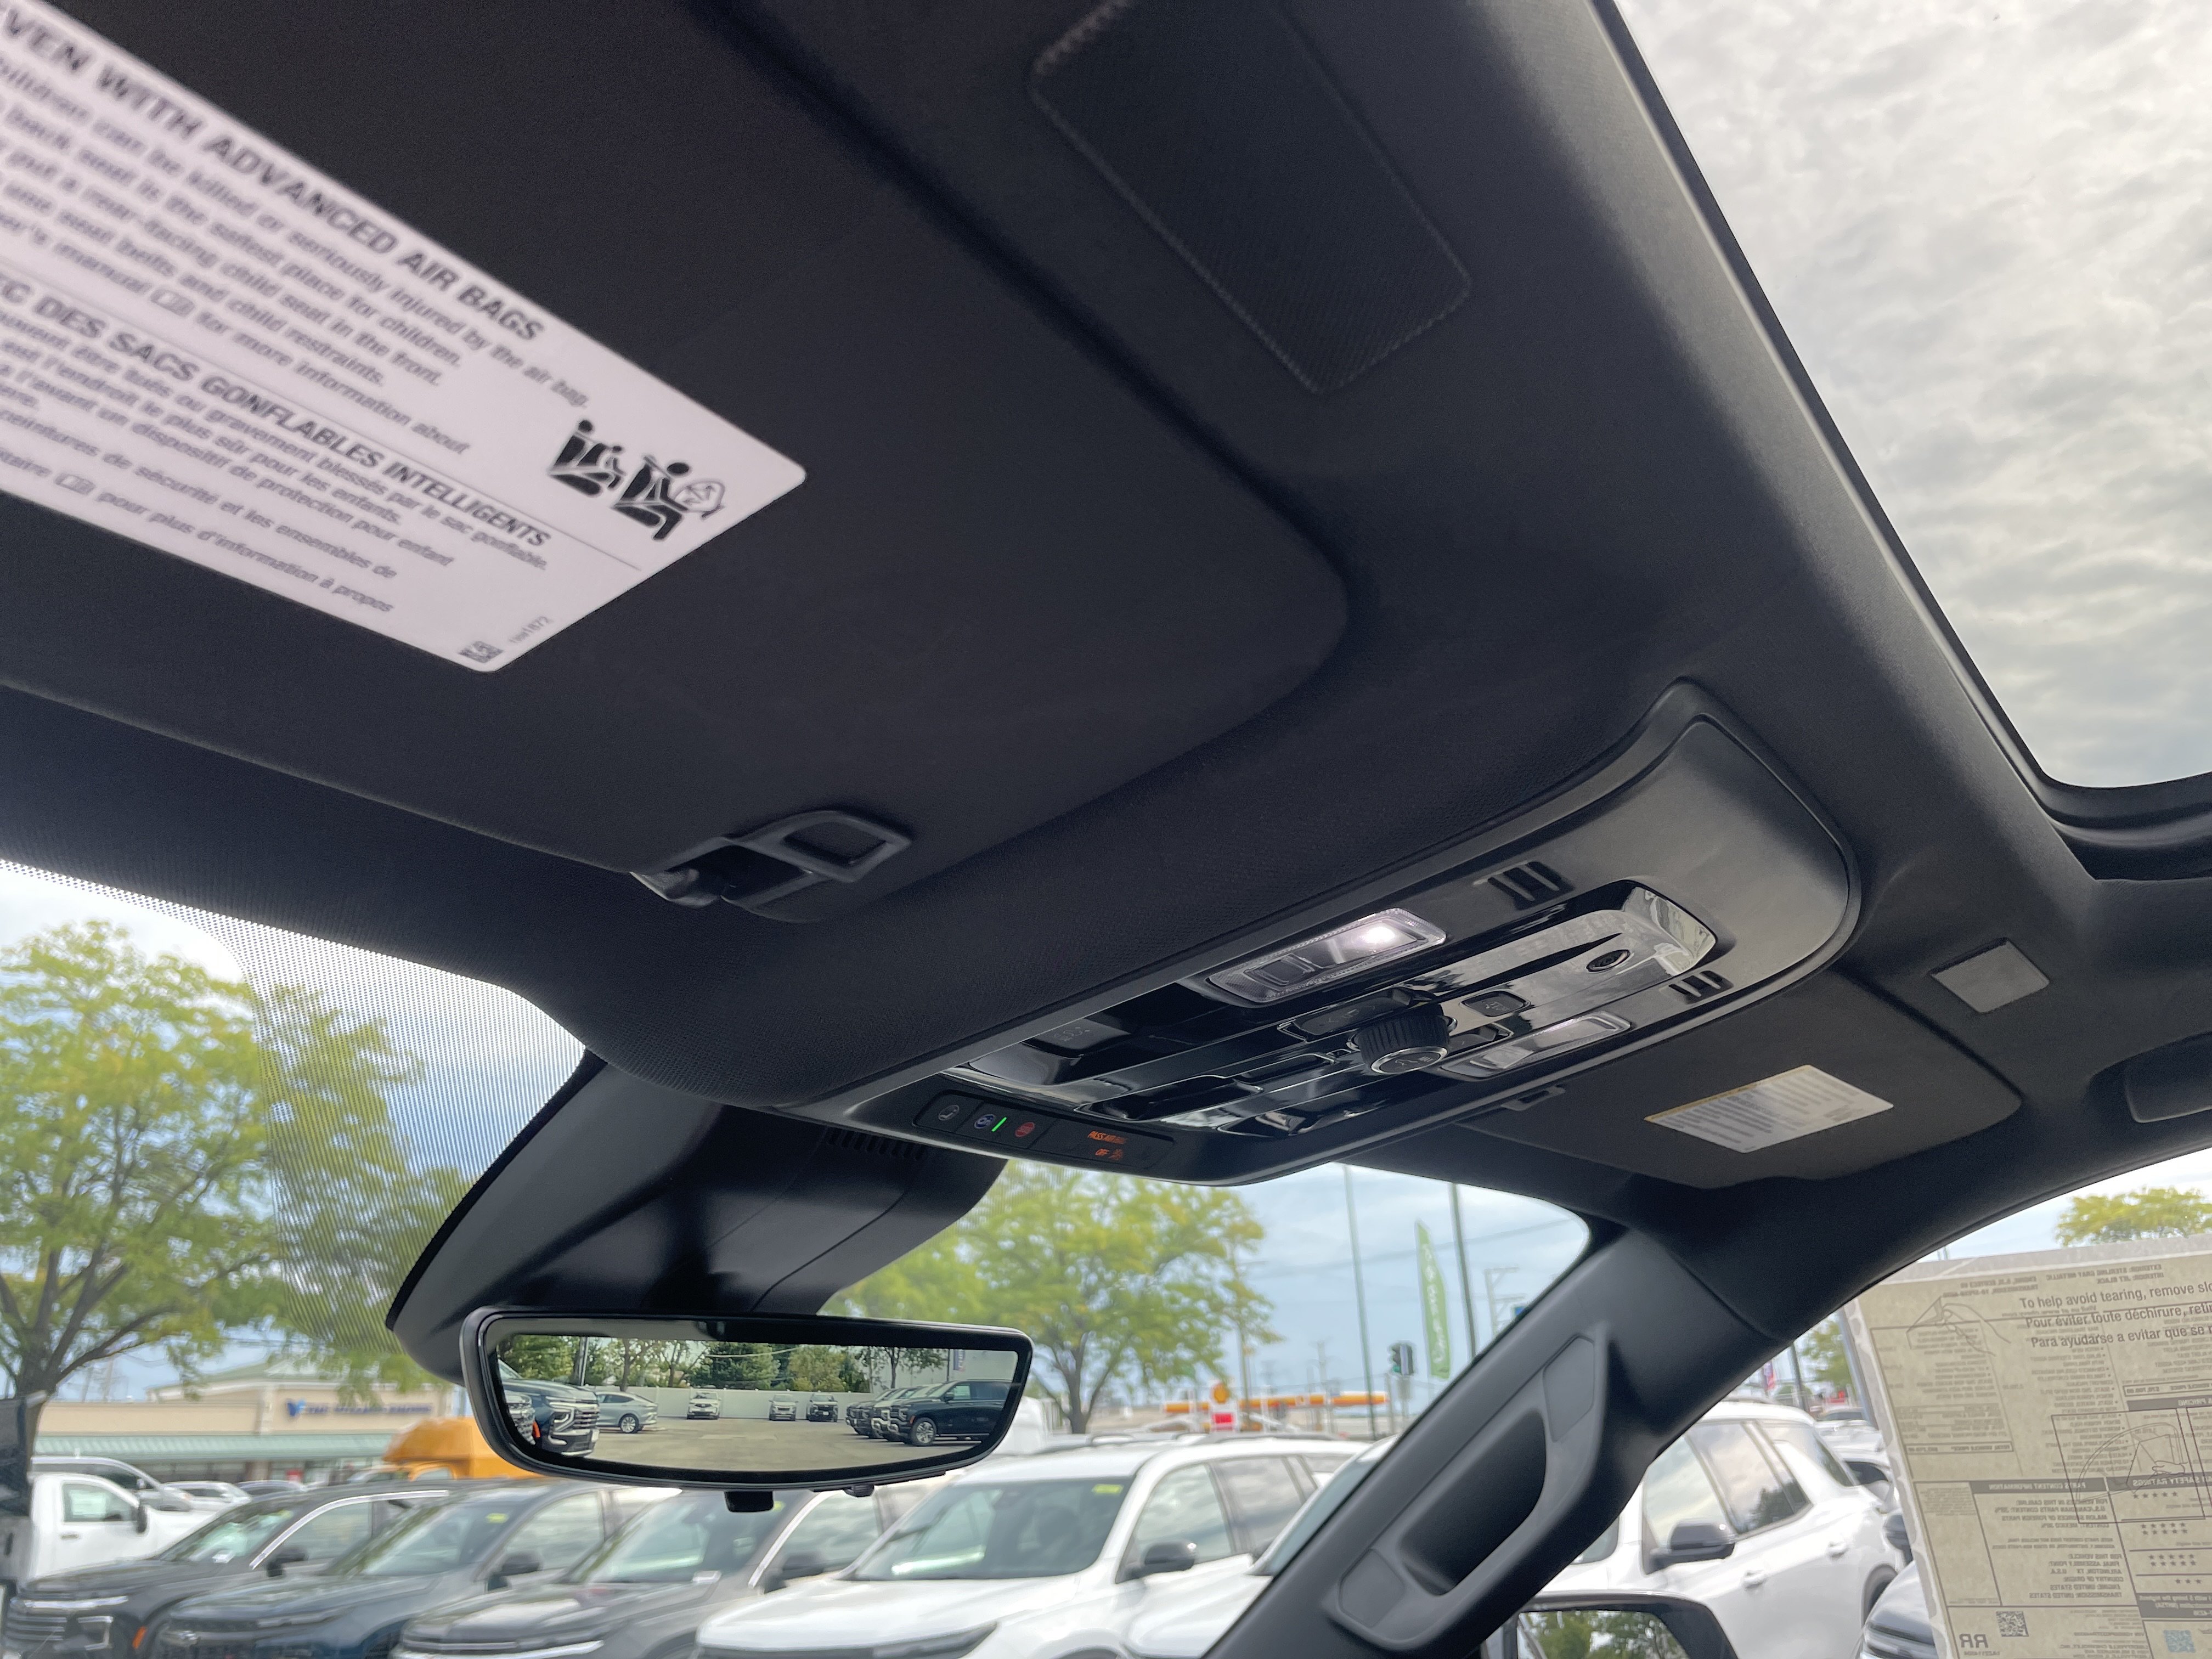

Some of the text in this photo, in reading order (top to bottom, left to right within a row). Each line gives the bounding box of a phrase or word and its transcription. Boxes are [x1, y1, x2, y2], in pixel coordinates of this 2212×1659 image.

[97, 67, 202, 138] WITH
[204, 137, 397, 253] ADVANCED
[397, 252, 458, 290] AIR
[458, 285, 543, 339] BAGS
[34, 297, 550, 545] DES SACS GONFLABLES INTELLIGENTS
[2019, 1297, 2034, 1309] To
[2036, 1295, 2062, 1311] help
[2066, 1293, 2097, 1306] avoid
[2100, 1288, 2146, 1305] tearing,
[2149, 1284, 2195, 1298] remove
[2025, 1316, 2053, 1329] Pour
[2056, 1312, 2089, 1327] éviter
[2091, 1311, 2122, 1324] toute
[2125, 1306, 2186, 1323] déchirure,
[2032, 1336, 2058, 1347] Para
[2061, 1333, 2114, 1349] ayudarse
[2128, 1329, 2160, 1342] evitar
[2165, 1328, 2188, 1341] que
